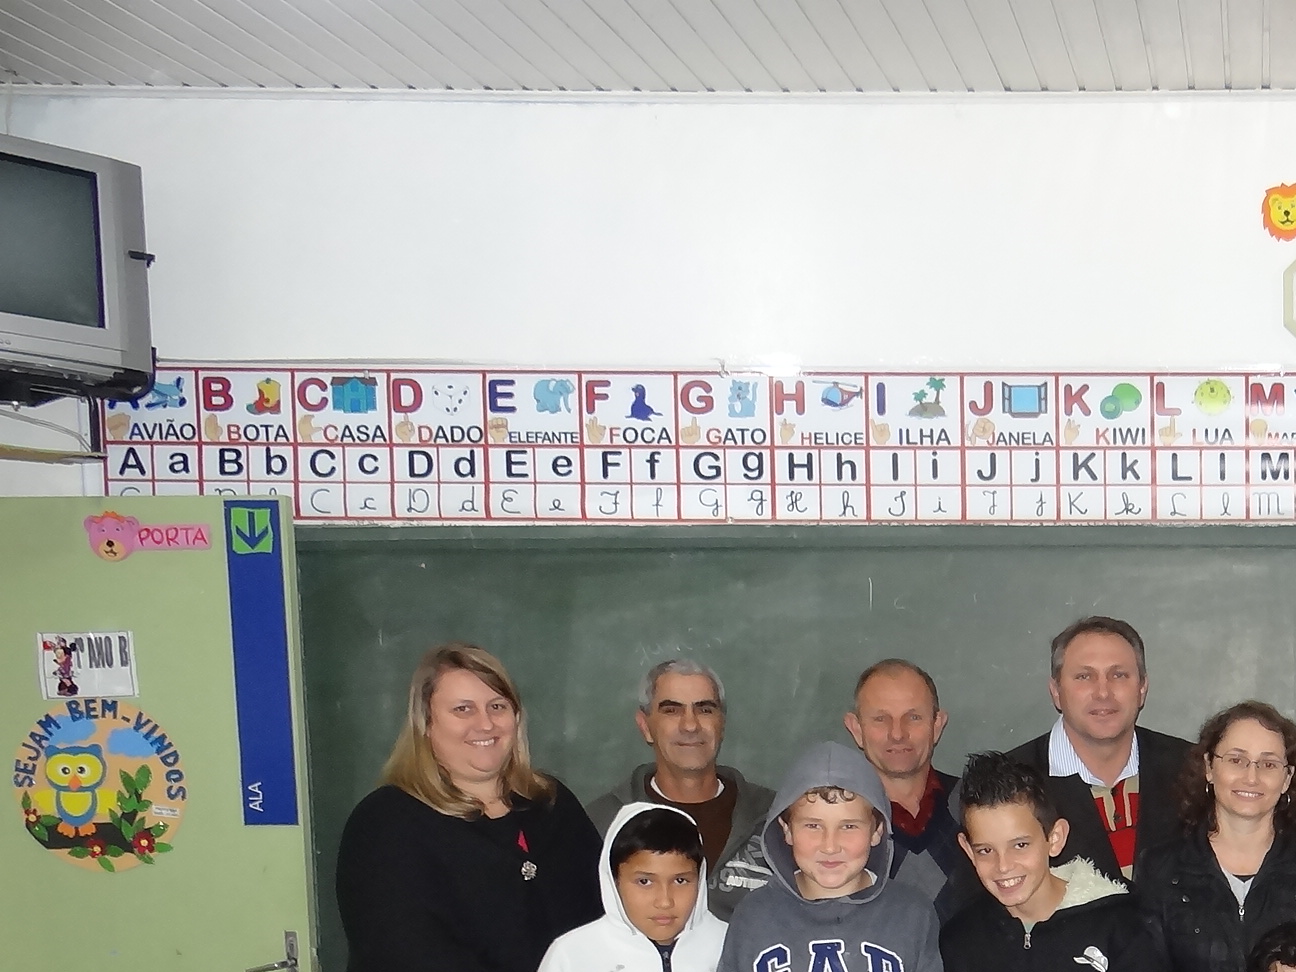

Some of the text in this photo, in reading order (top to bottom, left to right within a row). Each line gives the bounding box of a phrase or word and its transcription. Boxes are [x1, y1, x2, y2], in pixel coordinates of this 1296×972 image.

[202, 376, 233, 412] B
[297, 377, 328, 412] C
[392, 378, 423, 413] D
[488, 379, 517, 414] E
[585, 380, 611, 415] F
[680, 380, 714, 415] G
[774, 380, 805, 416] H
[876, 382, 886, 416] I
[969, 381, 993, 417] J
[1064, 384, 1091, 418] K
[1156, 381, 1181, 417] L
[1250, 382, 1284, 416] M
[129, 419, 196, 440] AVIÃO
[227, 424, 290, 442] BOTA
[323, 425, 388, 442] CASA
[418, 425, 484, 443] DADO
[508, 431, 579, 445] ELEFANTE
[609, 427, 673, 445] FOCA
[706, 428, 767, 446] GATO
[800, 431, 864, 446] HELICE
[898, 428, 951, 446] ILHA
[986, 430, 1054, 447] JANELA
[1095, 427, 1147, 446] KIWI
[1192, 428, 1235, 446] LUA
[119, 447, 146, 476] A
[169, 453, 190, 474] a
[219, 448, 244, 476] B
[265, 447, 288, 476] b
[310, 449, 336, 478] C
[358, 454, 379, 475] c
[408, 450, 434, 478] D
[453, 449, 476, 478] d
[505, 450, 530, 479] E
[552, 456, 572, 477] e
[602, 451, 621, 480] F
[646, 451, 661, 480] f
[693, 451, 722, 481] G
[743, 451, 764, 480] g
[788, 452, 814, 482] H
[836, 452, 858, 481] h
[931, 451, 939, 479] i
[977, 452, 996, 482] J
[1030, 451, 1041, 483] j
[1072, 451, 1098, 482] K
[1121, 451, 1141, 480] k
[1172, 452, 1192, 481] L
[137, 527, 208, 547] PORTA
[87, 635, 113, 669] ANO
[118, 635, 129, 668] B
[14, 713, 62, 789] SEJAM
[248, 781, 264, 812] ALA
